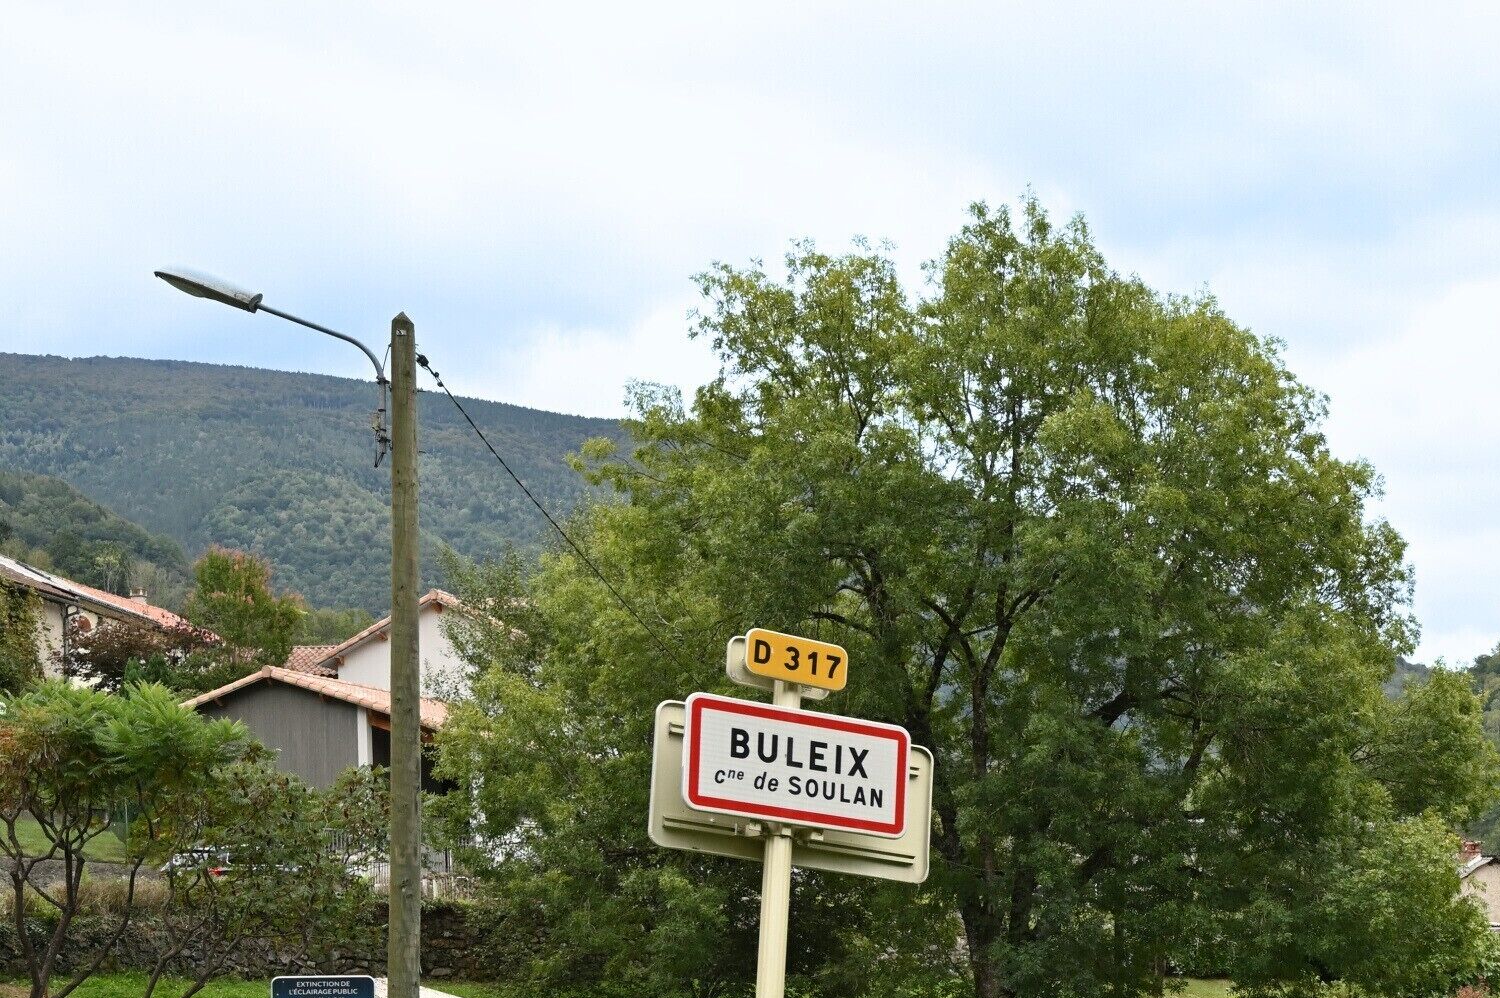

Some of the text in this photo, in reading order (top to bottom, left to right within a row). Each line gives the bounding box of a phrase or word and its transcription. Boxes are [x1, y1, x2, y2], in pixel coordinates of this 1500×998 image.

[753, 639, 841, 679] D 317
[730, 727, 870, 779] BULEIX
[754, 771, 779, 793] de
[788, 776, 883, 808] SOULAN
